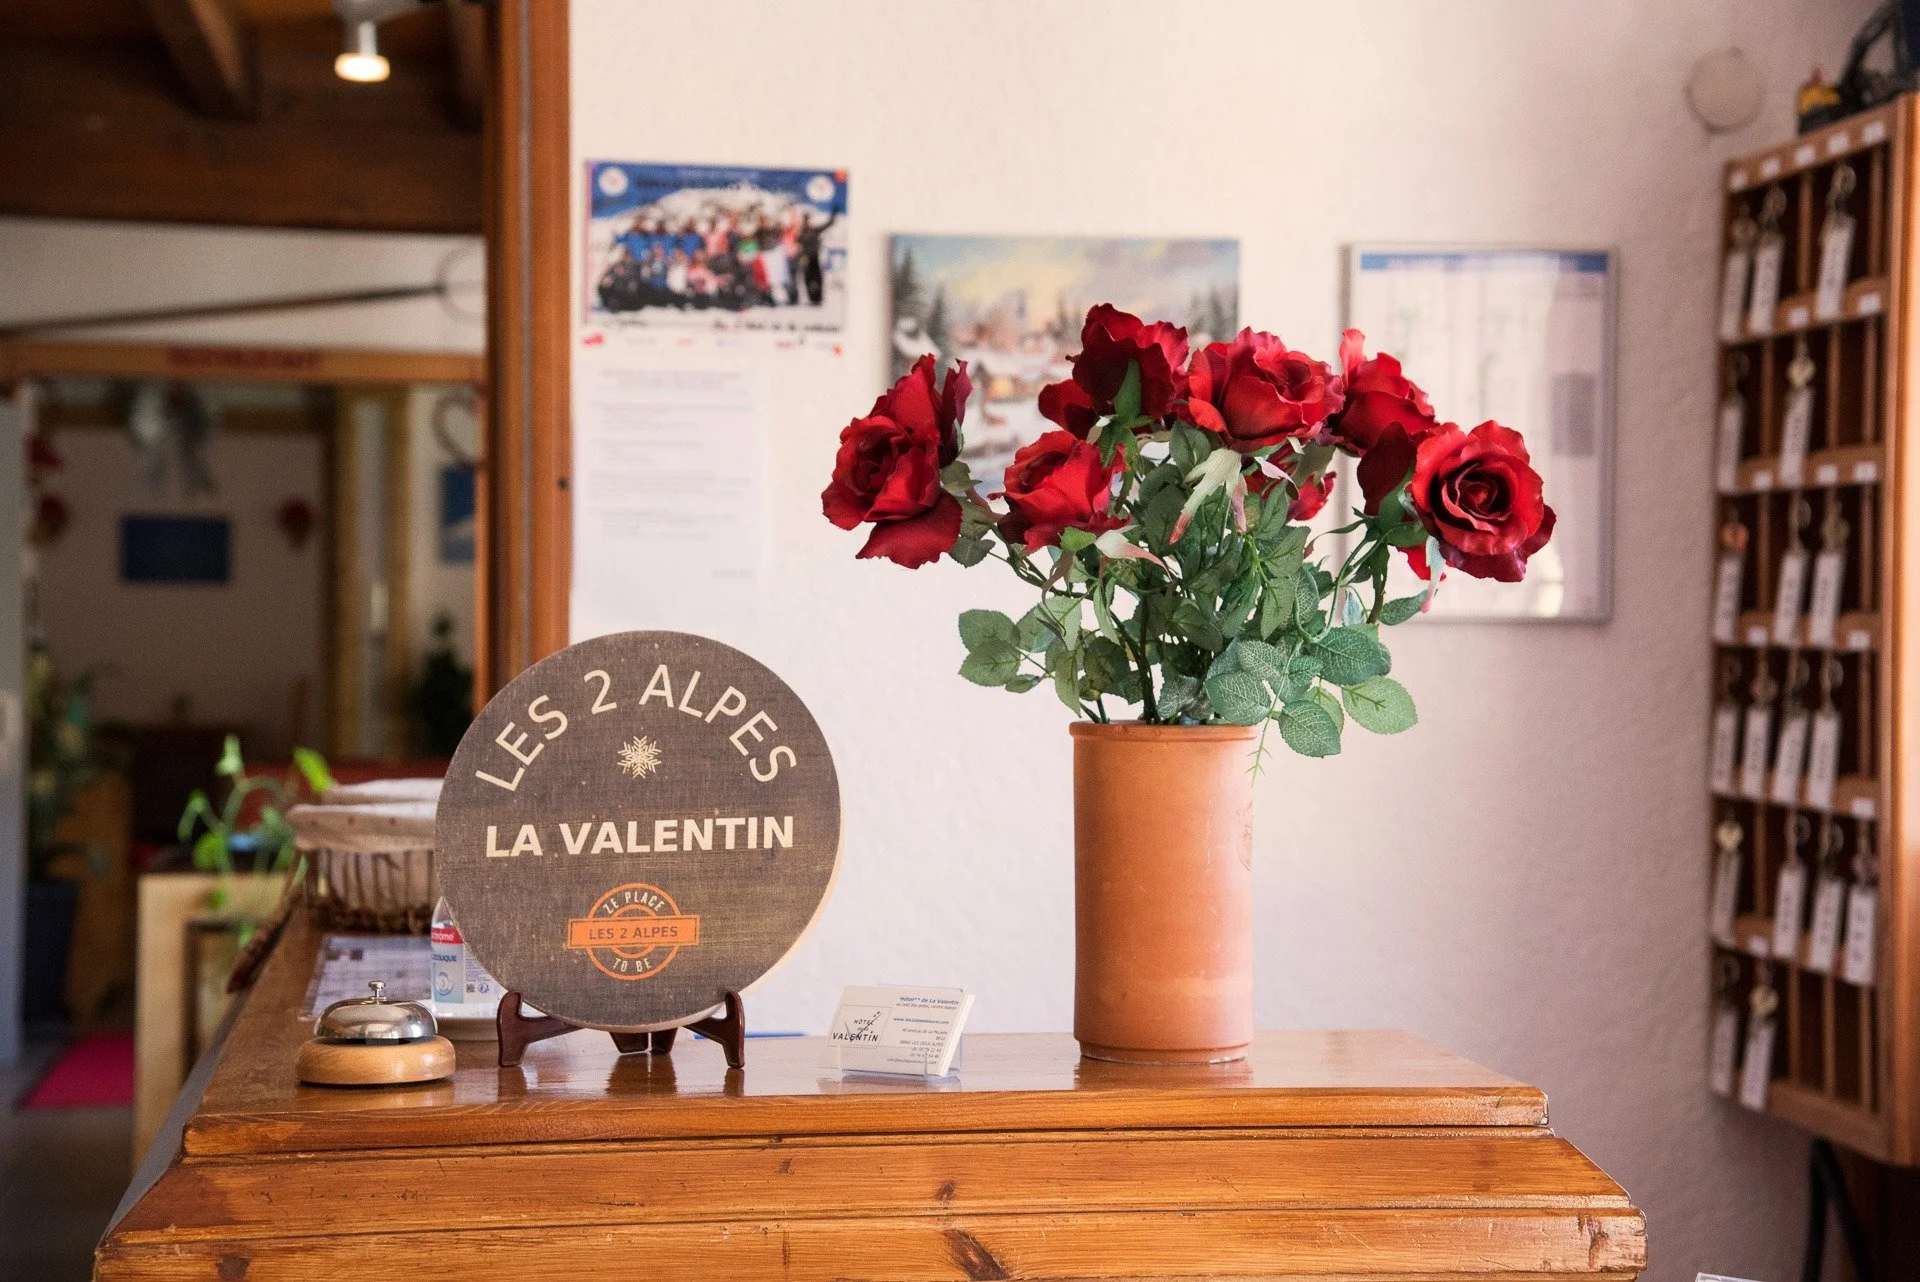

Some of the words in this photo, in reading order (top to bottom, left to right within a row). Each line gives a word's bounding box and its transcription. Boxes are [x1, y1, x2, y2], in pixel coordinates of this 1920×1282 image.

[475, 694, 569, 791] LES
[583, 669, 617, 714] 2
[639, 664, 797, 782] ALPES
[486, 825, 543, 858] LA
[559, 816, 794, 855] VALENTIN
[602, 898, 620, 914] ZE
[625, 891, 665, 911] PLACE
[588, 928, 614, 940] LES
[619, 928, 628, 939] 2
[633, 926, 678, 938] ALPES
[612, 958, 628, 972] TO
[635, 958, 652, 972] BE
